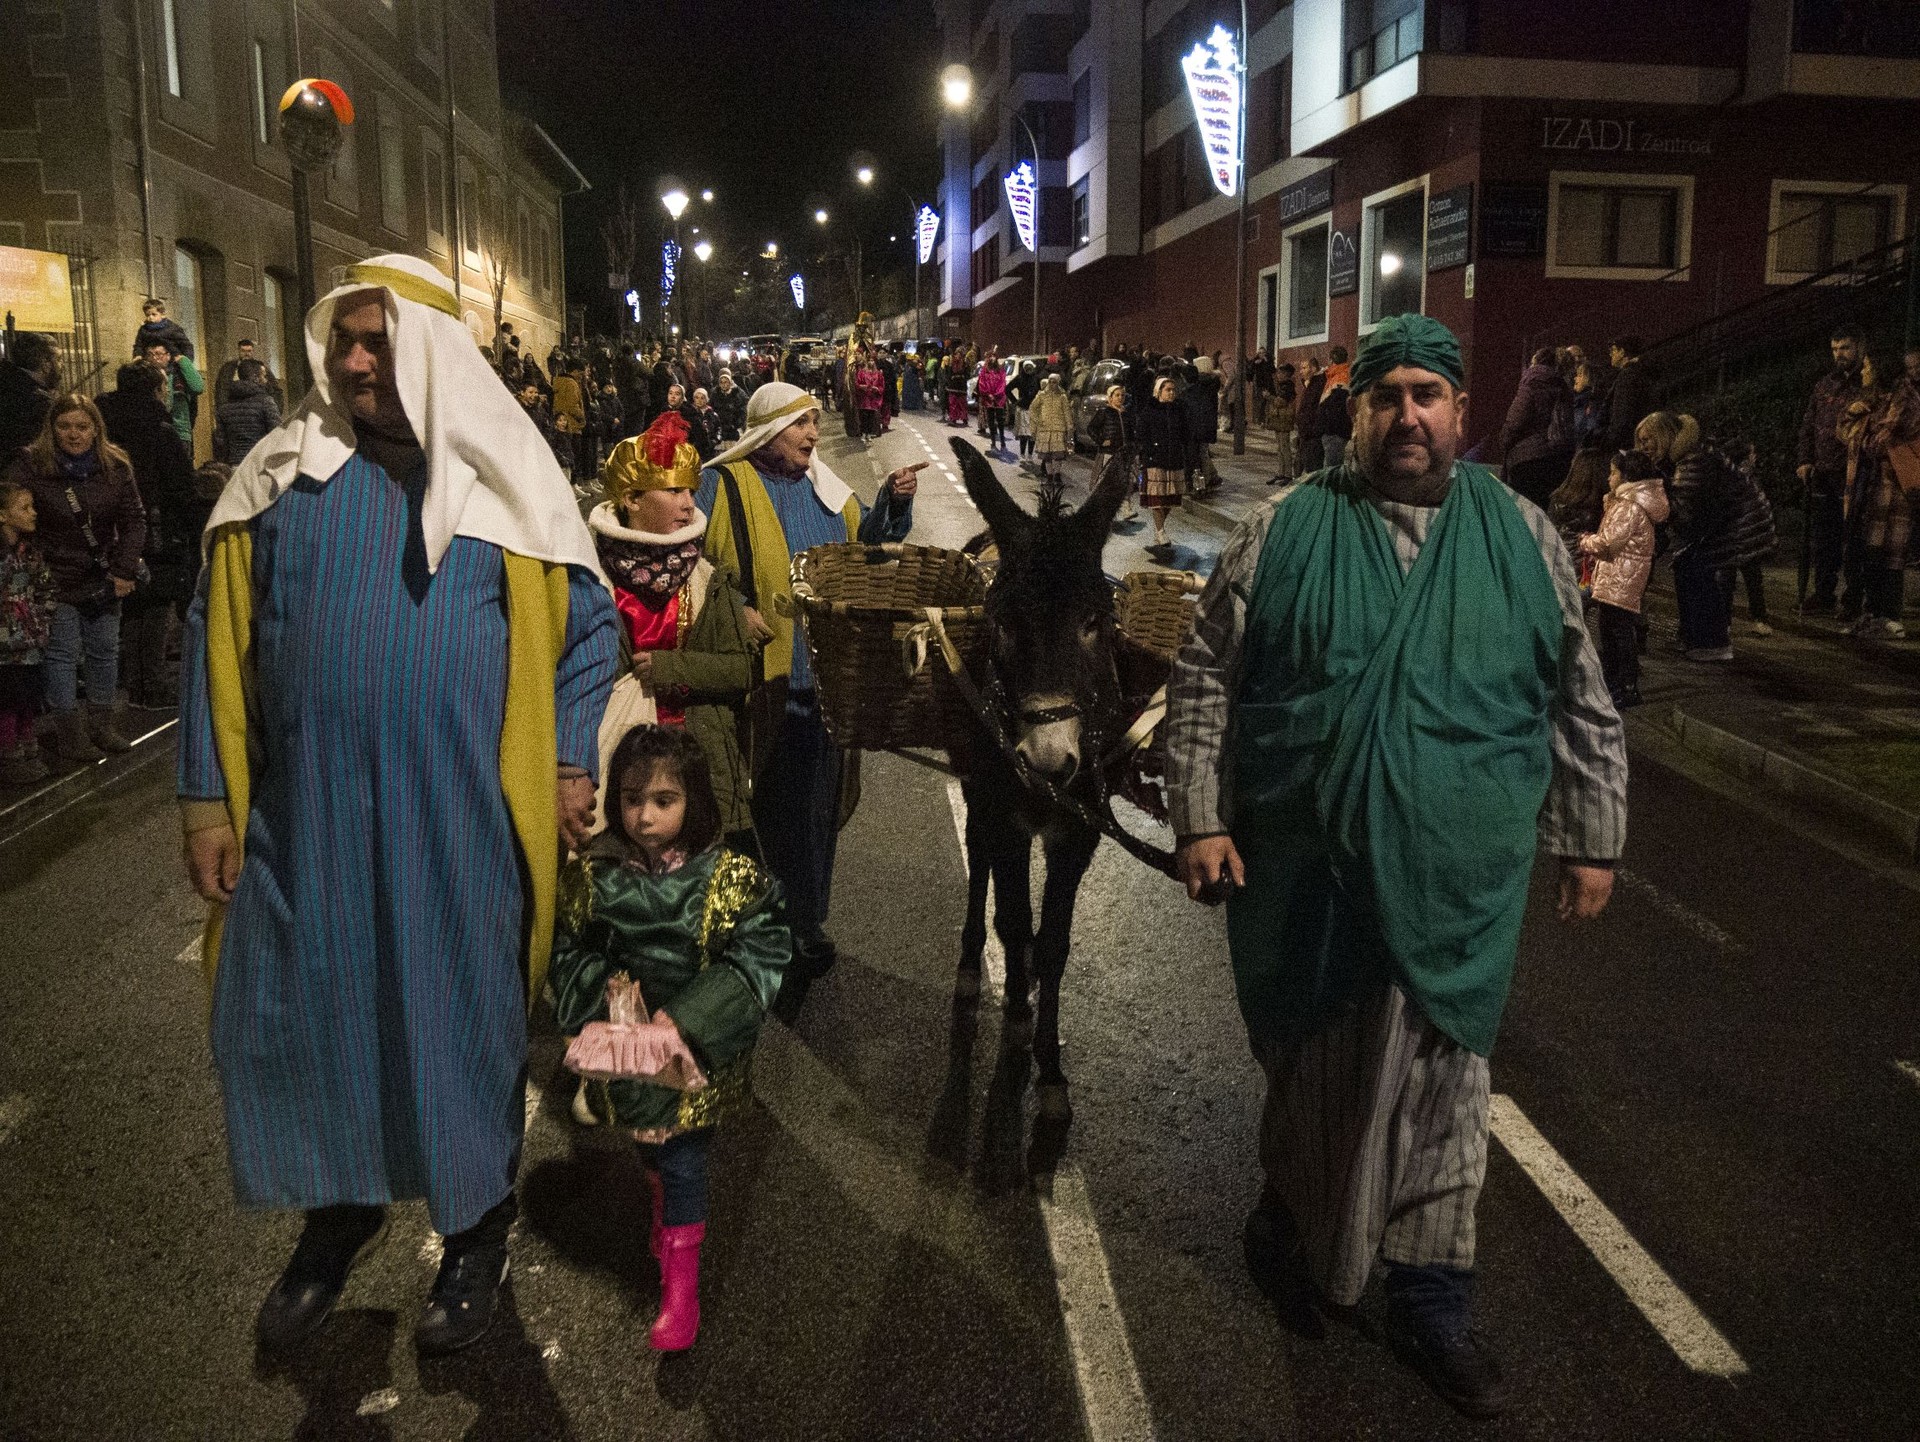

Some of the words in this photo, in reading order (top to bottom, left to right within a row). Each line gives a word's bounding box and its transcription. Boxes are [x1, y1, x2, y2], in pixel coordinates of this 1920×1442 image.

[1540, 117, 1635, 151] IZADI
[1640, 132, 1712, 154] Zentroa
[1280, 187, 1306, 220] IZADI
